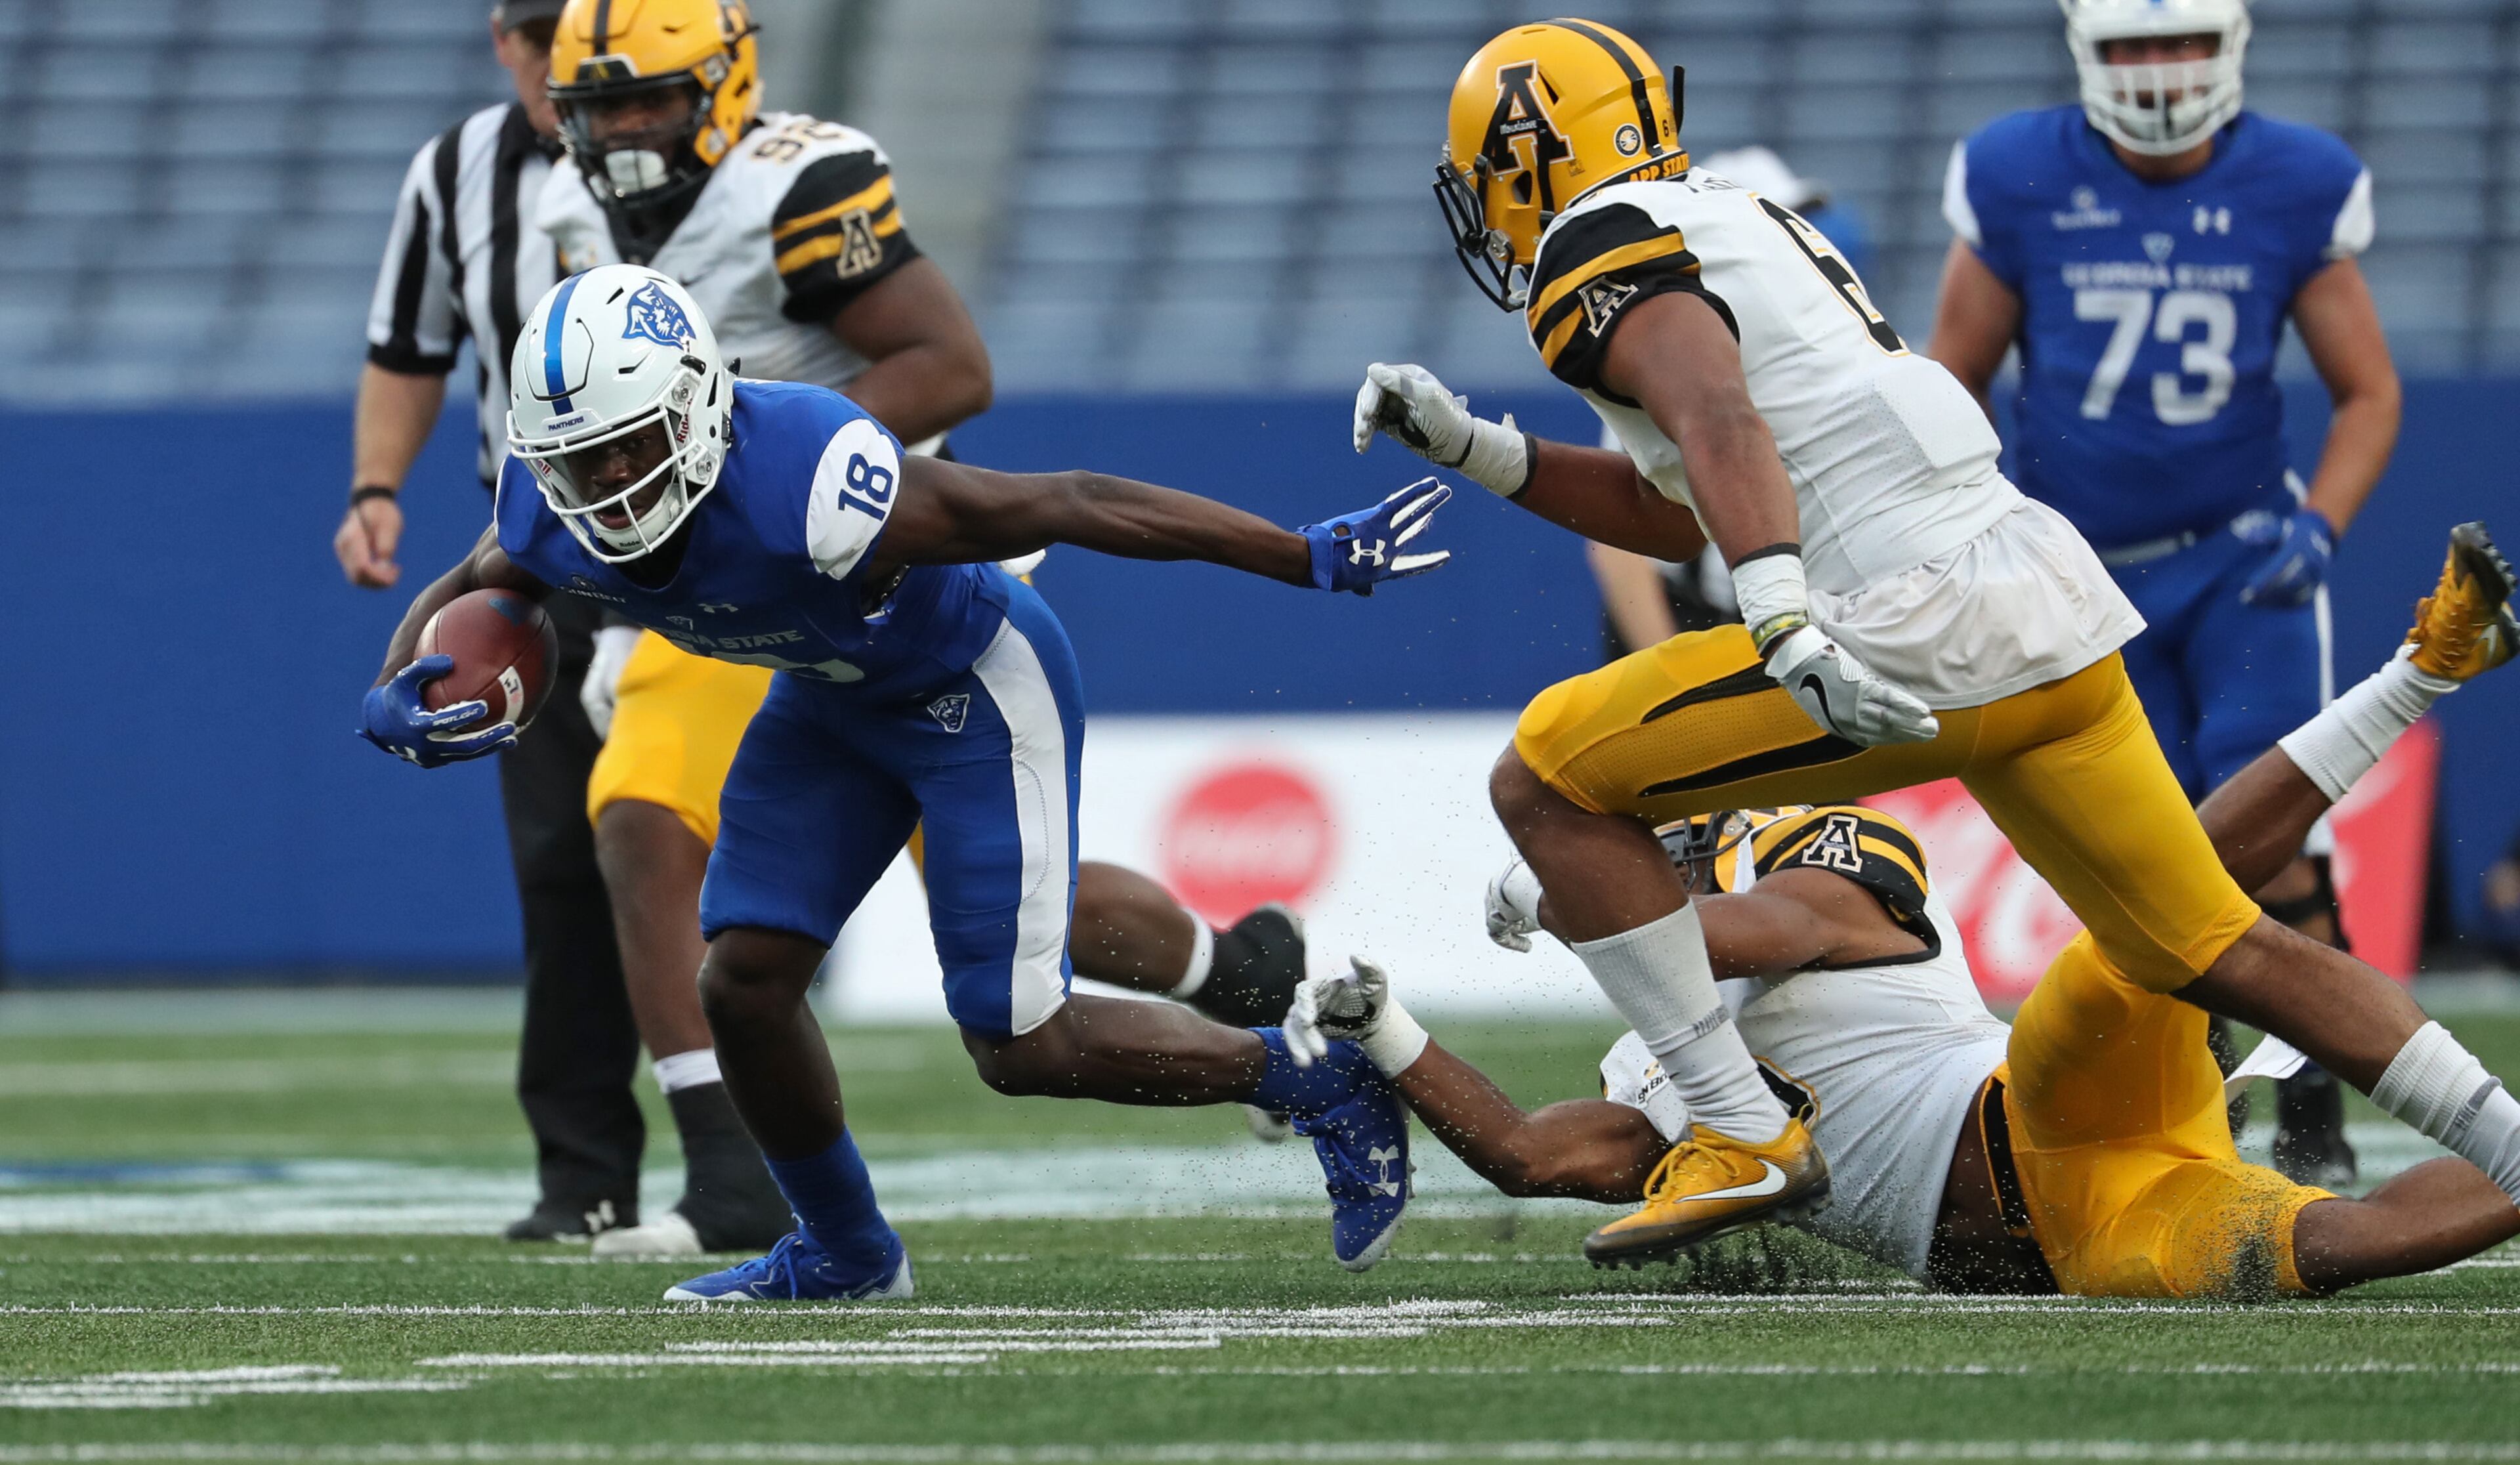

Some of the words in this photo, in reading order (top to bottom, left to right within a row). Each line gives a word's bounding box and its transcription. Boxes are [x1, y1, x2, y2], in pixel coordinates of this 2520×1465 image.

[1487, 59, 1575, 176] A
[1662, 119, 1670, 137] 6
[1629, 165, 1660, 181] APP
[836, 206, 883, 279] A
[1578, 275, 1639, 338] A
[2074, 289, 2237, 425] 73
[548, 416, 584, 431] PANTHERS
[838, 453, 893, 521] 18
[719, 630, 805, 649] STATE
[432, 708, 480, 727] SPOTLIGHT
[1801, 815, 1863, 873] A
